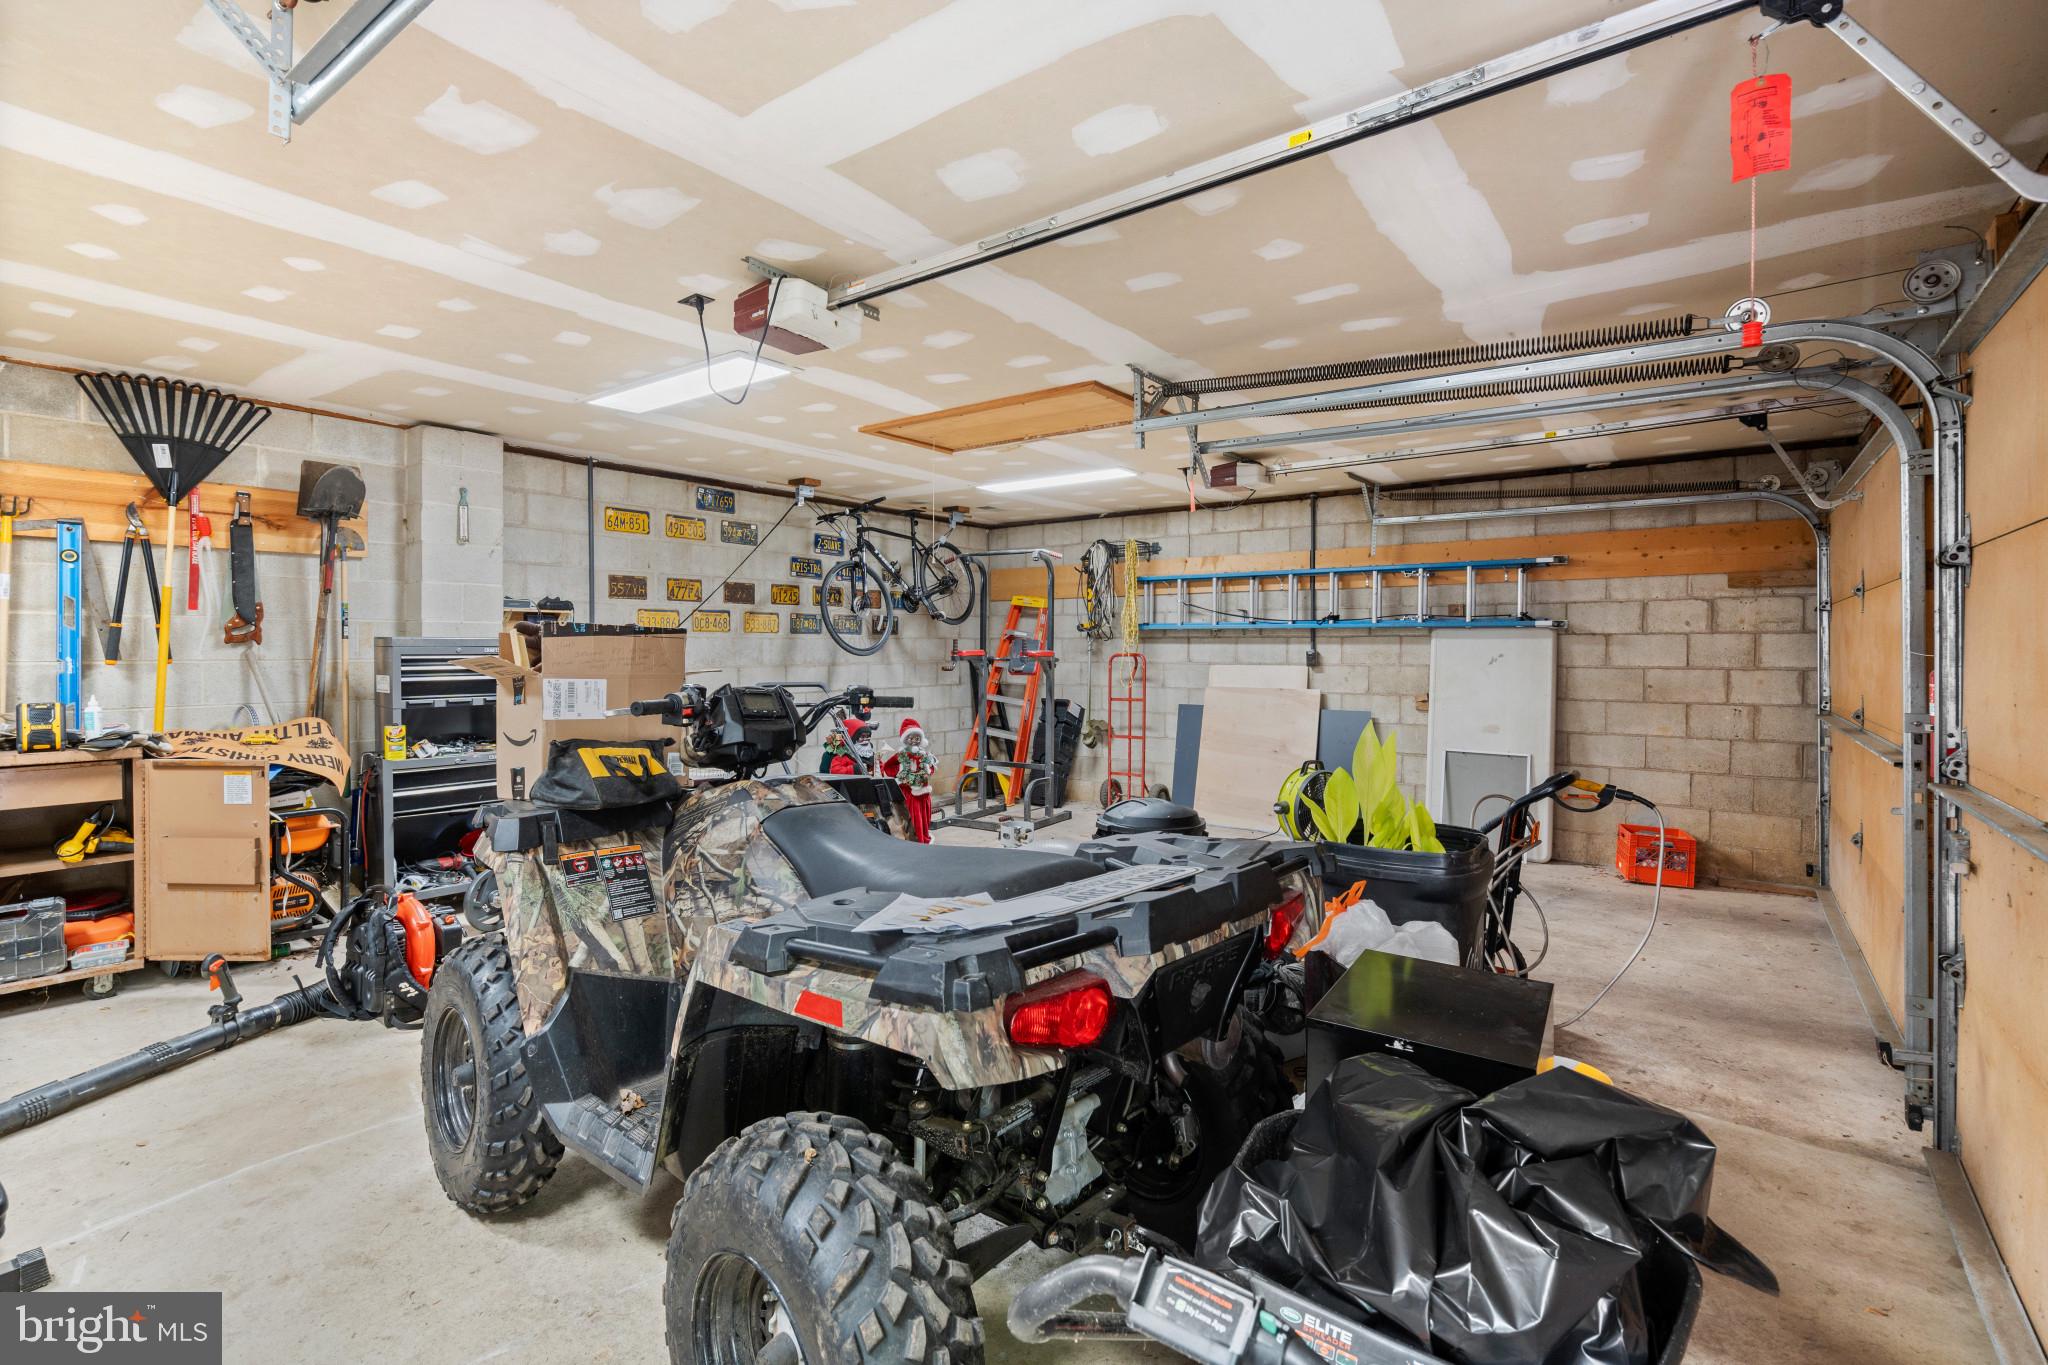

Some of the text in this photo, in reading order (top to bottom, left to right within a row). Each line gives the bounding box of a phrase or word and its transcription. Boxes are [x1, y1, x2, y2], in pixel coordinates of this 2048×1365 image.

[287, 753, 344, 777] MERRY
[1302, 1324, 1352, 1351] SPREADER
[1303, 1312, 1353, 1345] ELITE
